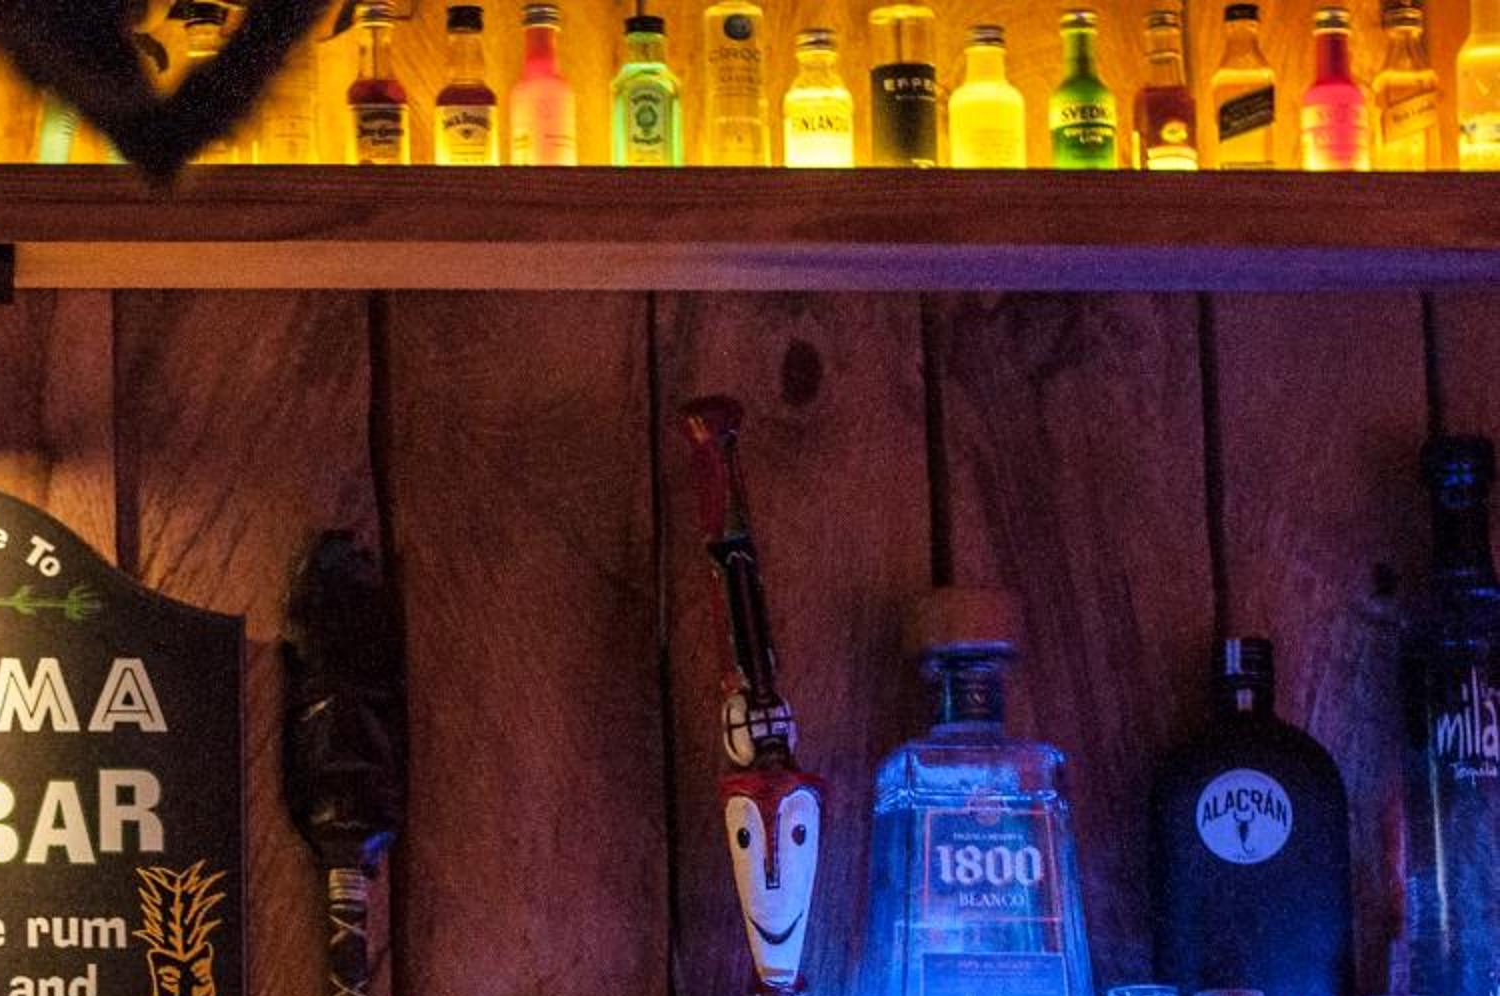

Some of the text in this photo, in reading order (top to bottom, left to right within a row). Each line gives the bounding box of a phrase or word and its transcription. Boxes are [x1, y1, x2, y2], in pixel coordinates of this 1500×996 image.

[23, 535, 63, 578] To
[1202, 787, 1288, 828] ALACRÁN
[936, 844, 1044, 885] 1800
[959, 891, 1026, 907] BLANCO
[26, 914, 128, 950] rum
